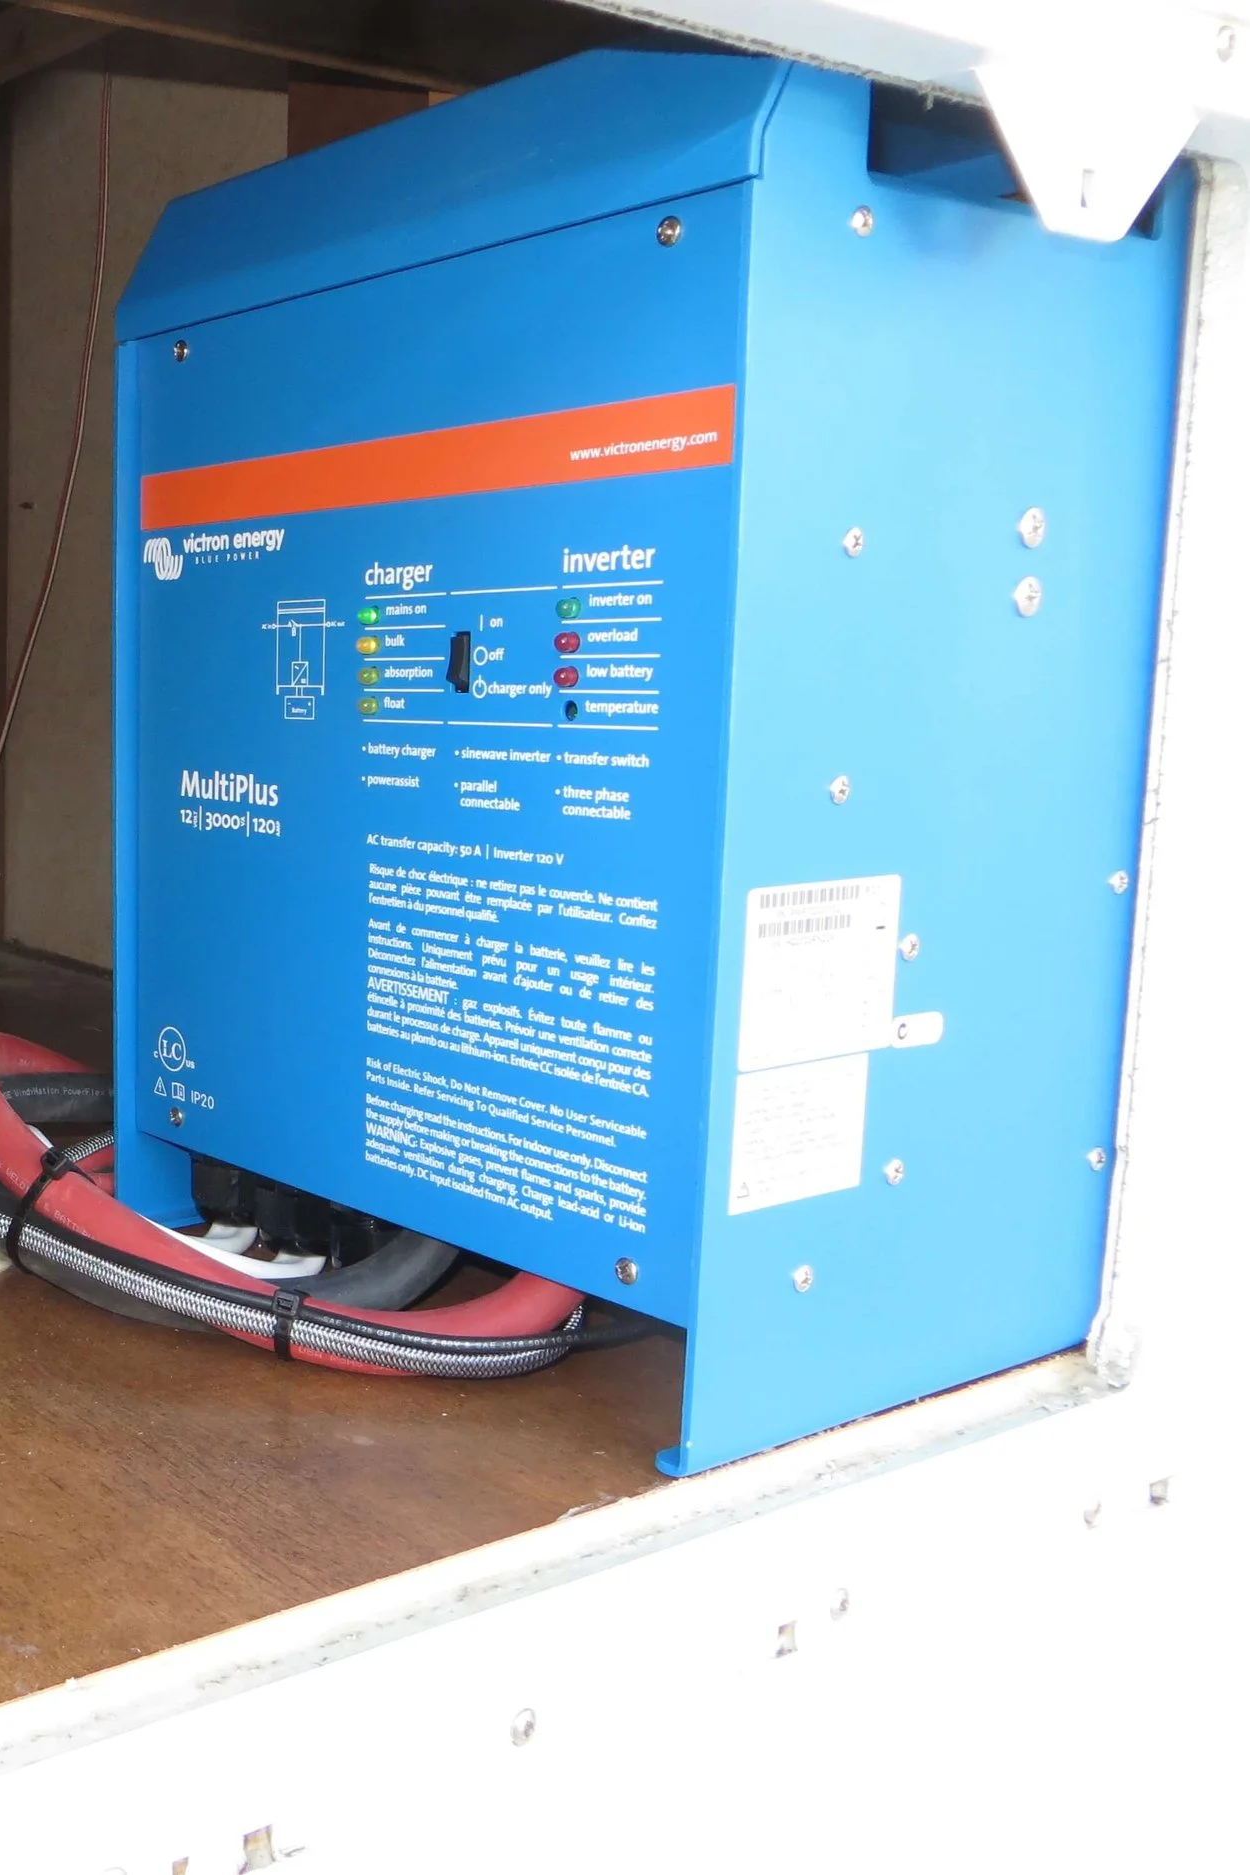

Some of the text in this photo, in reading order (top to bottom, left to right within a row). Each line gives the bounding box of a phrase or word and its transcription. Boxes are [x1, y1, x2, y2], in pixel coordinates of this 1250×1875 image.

[570, 432, 718, 460] www.victronenergy.com
[182, 529, 284, 554] victron energy
[196, 551, 260, 564] BLUE POWER
[563, 545, 655, 573] inverter
[365, 562, 433, 590] charger
[589, 593, 652, 606] inverter on
[386, 604, 427, 615] mains on
[490, 618, 503, 627] on
[385, 635, 404, 646] bulk
[587, 628, 638, 642] overload
[489, 648, 504, 660] off
[384, 666, 433, 680] absorption
[587, 664, 653, 681] low battery
[487, 682, 552, 698] charger only
[384, 697, 405, 708] float
[585, 701, 659, 716] temperature
[368, 743, 436, 760] battery charger
[461, 747, 551, 762] sinewave inverter
[564, 752, 649, 767] transfer switch
[181, 770, 278, 807] MultiPlus
[367, 776, 419, 787] powerassist
[461, 780, 497, 793] parallel
[563, 786, 629, 803] three phase
[460, 798, 520, 811] connectable
[563, 806, 631, 820] connectable
[181, 809, 192, 824] 12
[206, 812, 240, 830] 3000
[253, 818, 275, 834] 120
[367, 834, 378, 844] AC
[381, 836, 416, 848] transfer
[460, 845, 472, 856] 50
[473, 845, 481, 856] A
[494, 847, 534, 862] Inverter
[536, 854, 554, 864] 120
[556, 853, 564, 865] V
[370, 863, 394, 877] Risque
[396, 866, 406, 877] de
[408, 869, 426, 880] choc
[476, 879, 488, 888] ne
[489, 880, 517, 892] retirez
[519, 884, 536, 896] pas
[538, 884, 547, 896] le
[598, 892, 614, 905] Ne
[615, 897, 658, 911] contient
[369, 880, 397, 891] aucune
[426, 888, 460, 901] pouvant
[538, 903, 553, 915] par
[619, 912, 657, 929] Confiez
[368, 918, 390, 931] Avant
[396, 922, 406, 933] de
[412, 927, 458, 943] commencer
[476, 936, 509, 952] charger
[515, 942, 523, 954] la
[575, 954, 610, 969] veuillez
[618, 959, 634, 973] lire
[641, 962, 655, 976] les
[422, 942, 473, 961] Uniquement
[516, 960, 538, 973] pour
[547, 966, 560, 977] un
[570, 970, 599, 985] usage
[482, 970, 507, 983] avant
[559, 985, 572, 995] ou
[579, 986, 592, 999] de
[599, 992, 629, 1006] retirer
[636, 996, 654, 1011] des
[367, 977, 448, 1004] AVERTISSEMENT
[462, 999, 478, 1010] gaz
[561, 1017, 587, 1032] toute
[592, 1022, 632, 1041] flamme
[638, 1034, 653, 1045] ou
[191, 1091, 214, 1109] IP20
[366, 1056, 381, 1068] Risk
[383, 1062, 392, 1071] of
[393, 1063, 421, 1079] Electric
[450, 1078, 463, 1090] Do
[464, 1081, 480, 1095] Not
[482, 1086, 518, 1105] Remove
[550, 1103, 564, 1117] No
[566, 1107, 588, 1124] User
[589, 1113, 647, 1139] Serviceable
[366, 1138, 400, 1156] adequate
[404, 1151, 444, 1170] ventilation
[448, 1162, 475, 1182] during
[522, 1185, 554, 1205] Charge
[558, 1196, 600, 1219] lead-acid
[604, 1212, 615, 1224] or
[619, 1214, 646, 1233] Li-Ion
[420, 1138, 456, 1158] Explosive
[486, 1160, 519, 1177] prevent
[521, 1168, 551, 1187] flames
[553, 1180, 572, 1194] and
[609, 1197, 646, 1217] provide
